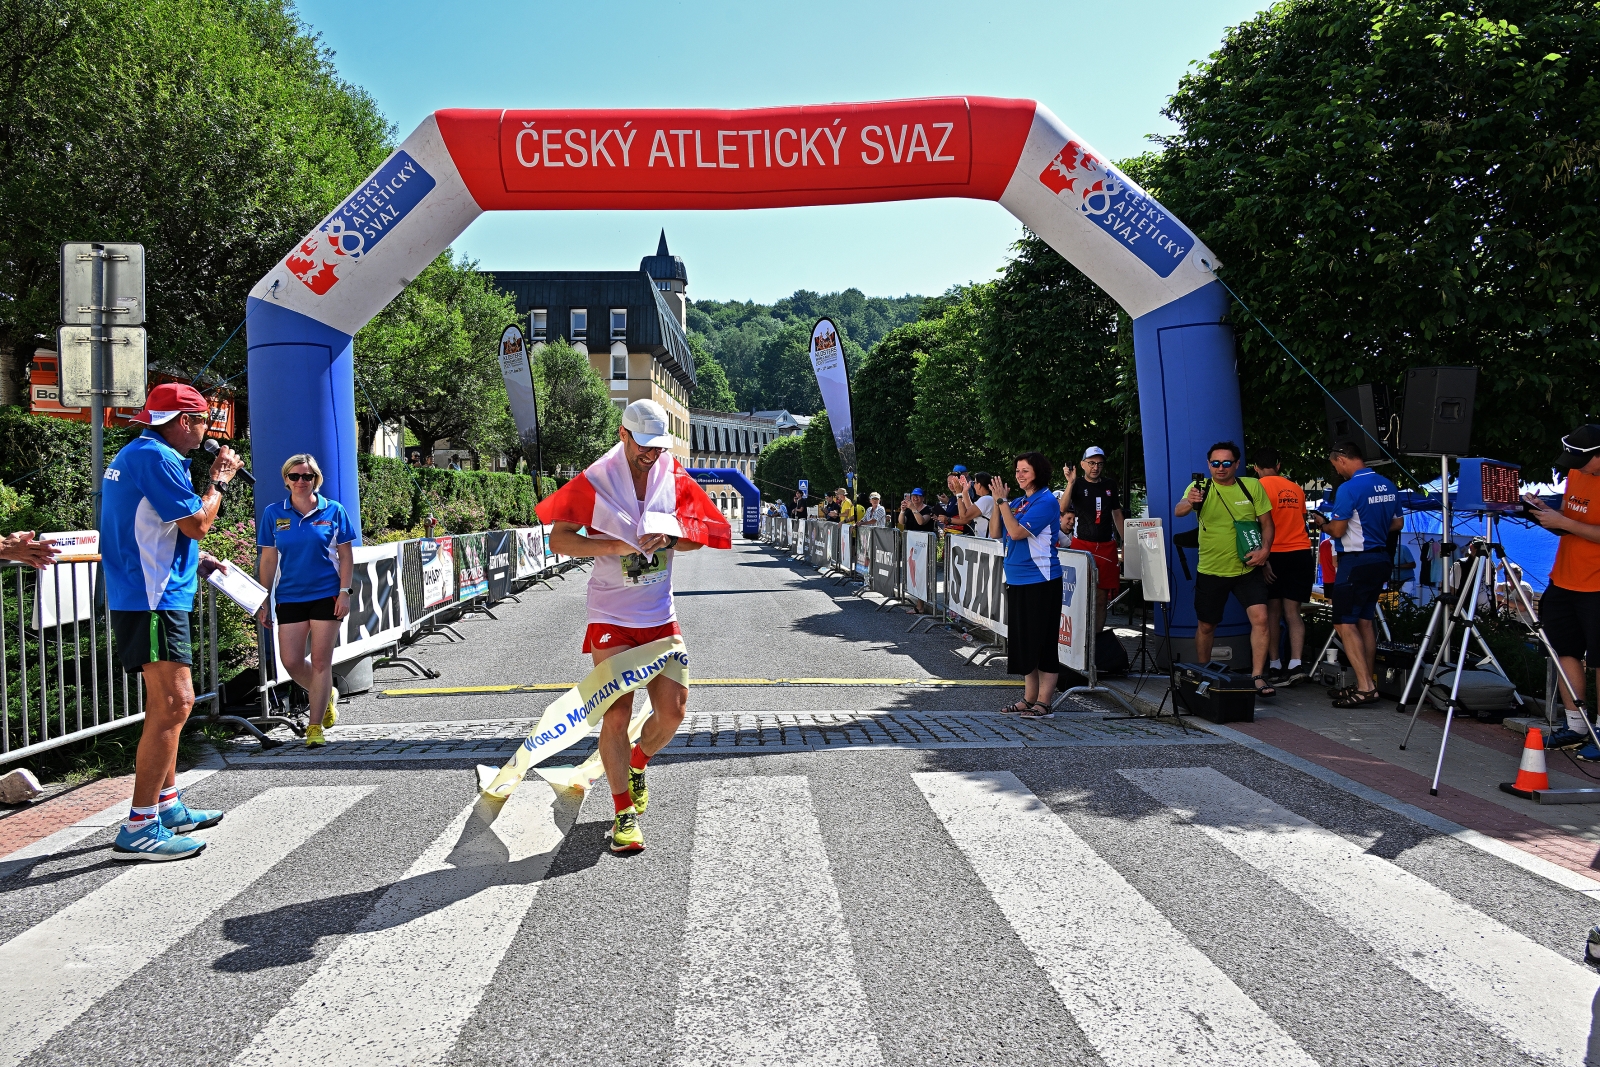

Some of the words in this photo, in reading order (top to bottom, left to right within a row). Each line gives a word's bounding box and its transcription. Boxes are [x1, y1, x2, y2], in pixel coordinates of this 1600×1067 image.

[515, 121, 637, 169] ČESKÝ
[647, 118, 846, 169] ATLETICKÝ
[860, 122, 955, 165] SVAZ
[343, 179, 380, 217] ČESKÝ
[352, 160, 417, 228] ATLETICKÝ
[1124, 189, 1165, 224] ČESKÝ
[363, 204, 400, 239] SVAZ
[1103, 213, 1141, 245] SVAZ
[1113, 201, 1185, 258] ATLETICKÝ
[1368, 493, 1396, 505] MEMBER
[1373, 484, 1388, 493] LOC
[950, 545, 1009, 625] STAR
[523, 722, 567, 752] WORLD
[566, 678, 621, 728] MOUNTAIN
